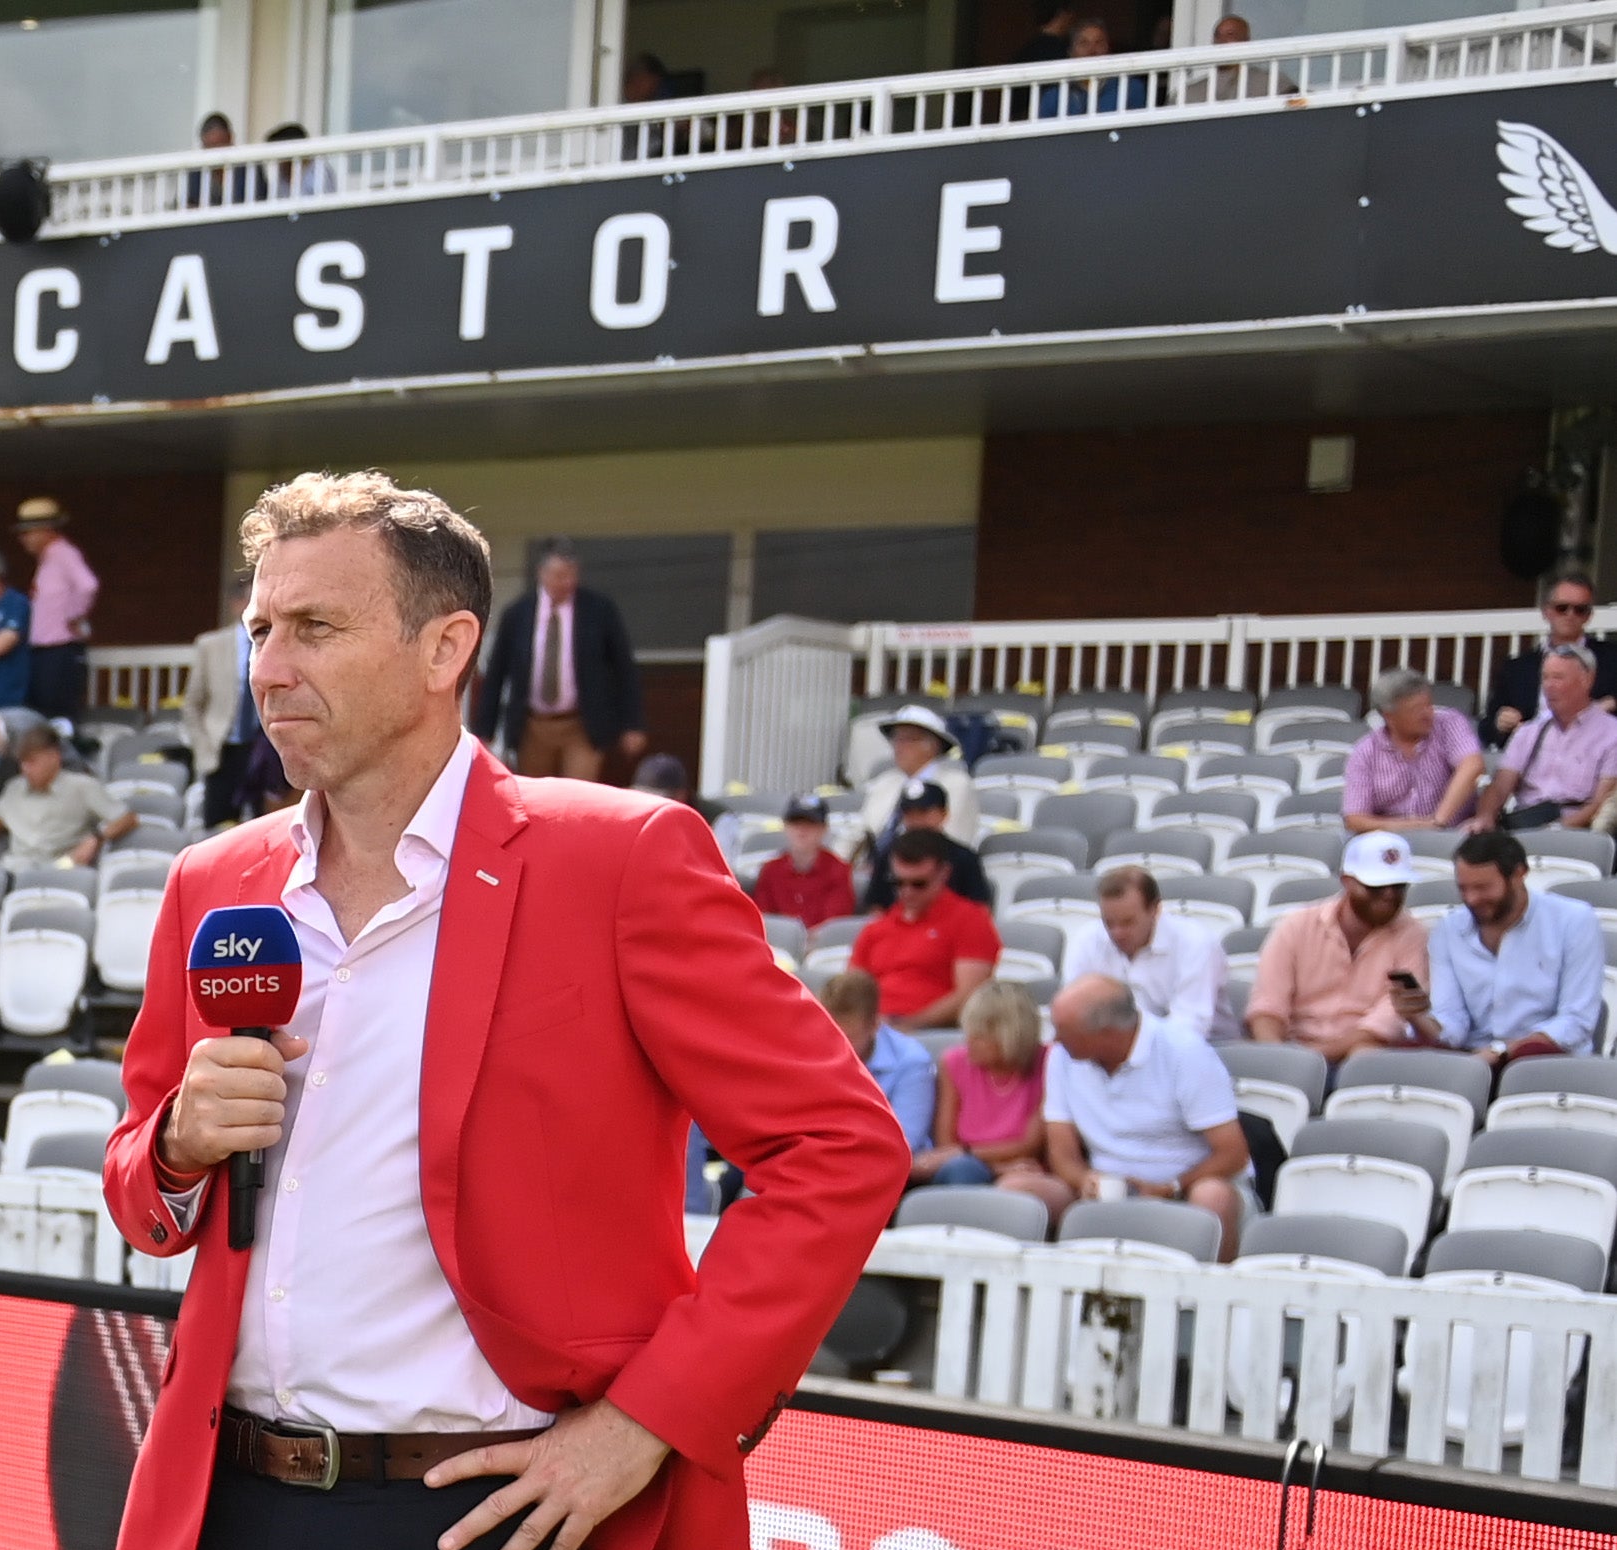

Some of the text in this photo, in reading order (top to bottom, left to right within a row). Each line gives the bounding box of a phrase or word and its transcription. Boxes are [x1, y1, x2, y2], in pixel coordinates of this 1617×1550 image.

[13, 178, 1012, 373] CASTORE
[213, 932, 263, 962] sky
[200, 973, 280, 999] sports
